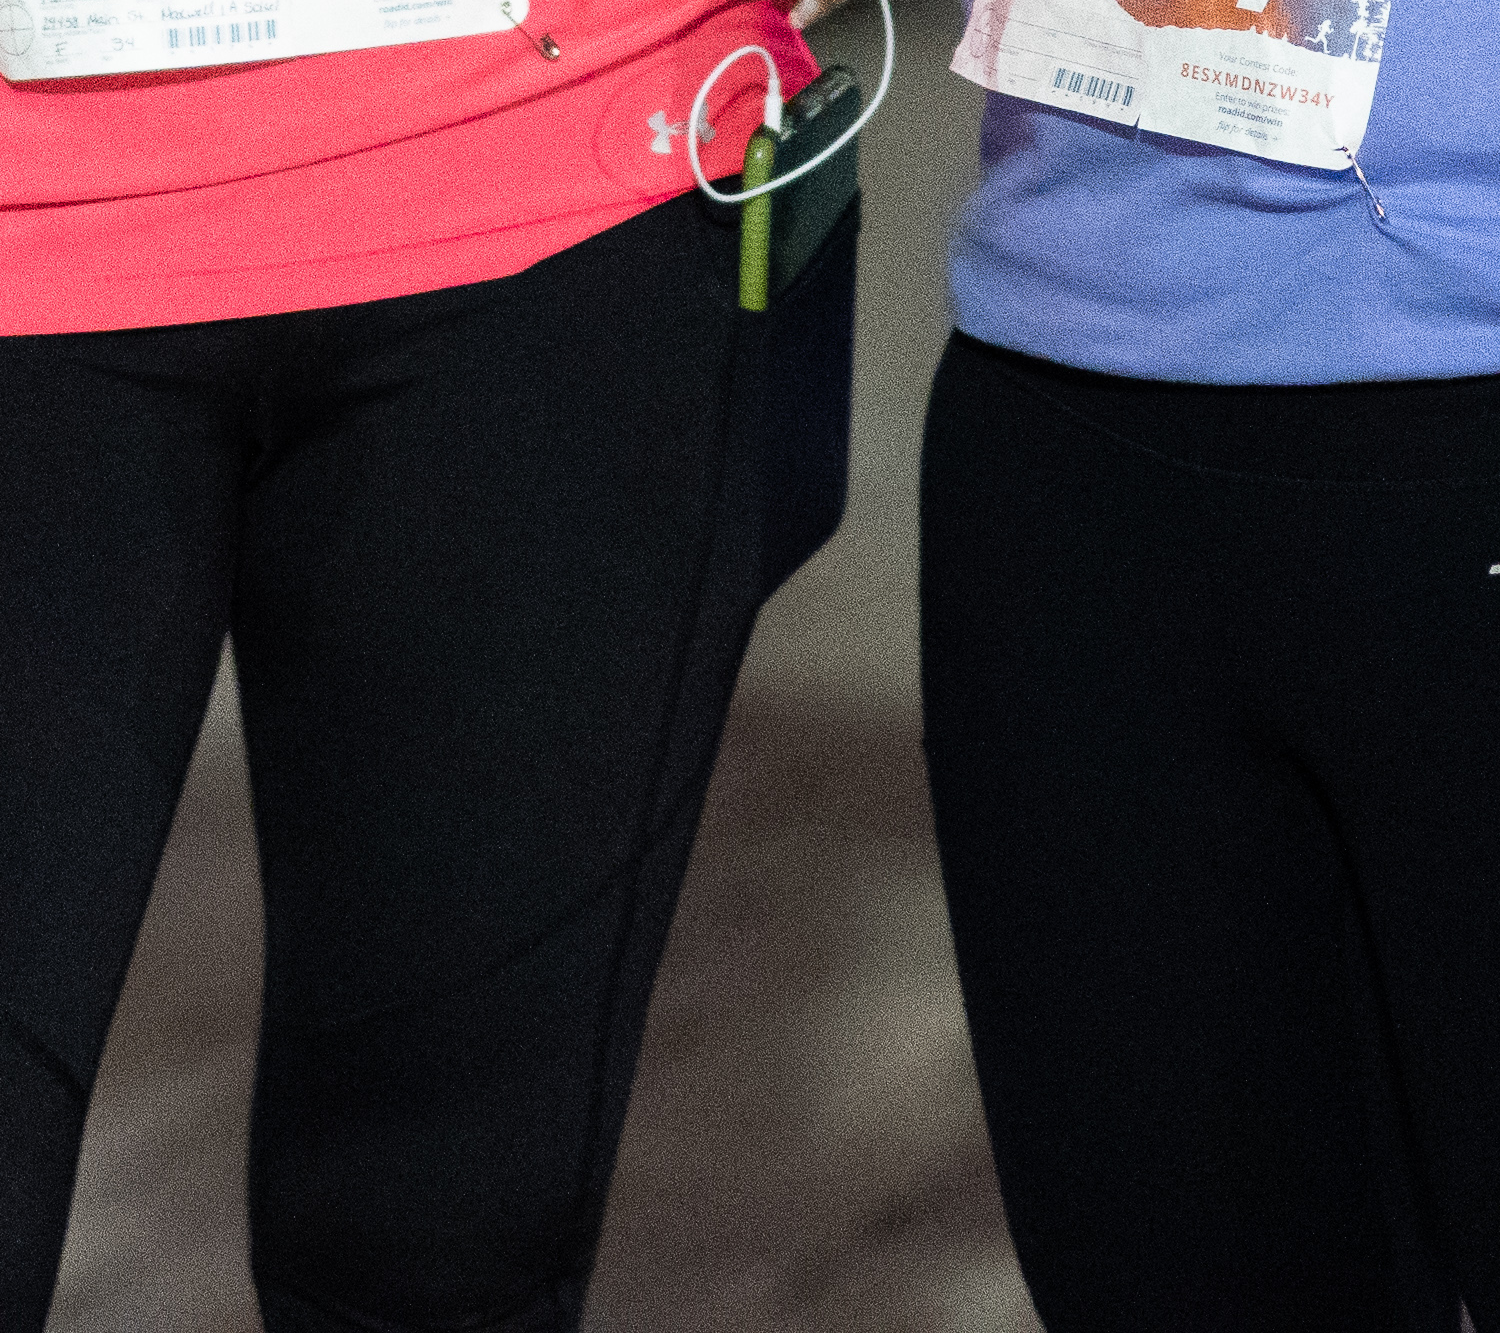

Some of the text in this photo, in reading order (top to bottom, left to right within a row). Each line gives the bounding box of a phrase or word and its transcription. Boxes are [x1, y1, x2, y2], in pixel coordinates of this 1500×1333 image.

[1238, 56, 1270, 71] Contest
[1214, 91, 1237, 104] Enter
[1237, 97, 1246, 106] to
[1217, 104, 1283, 127] roadid.com/win
